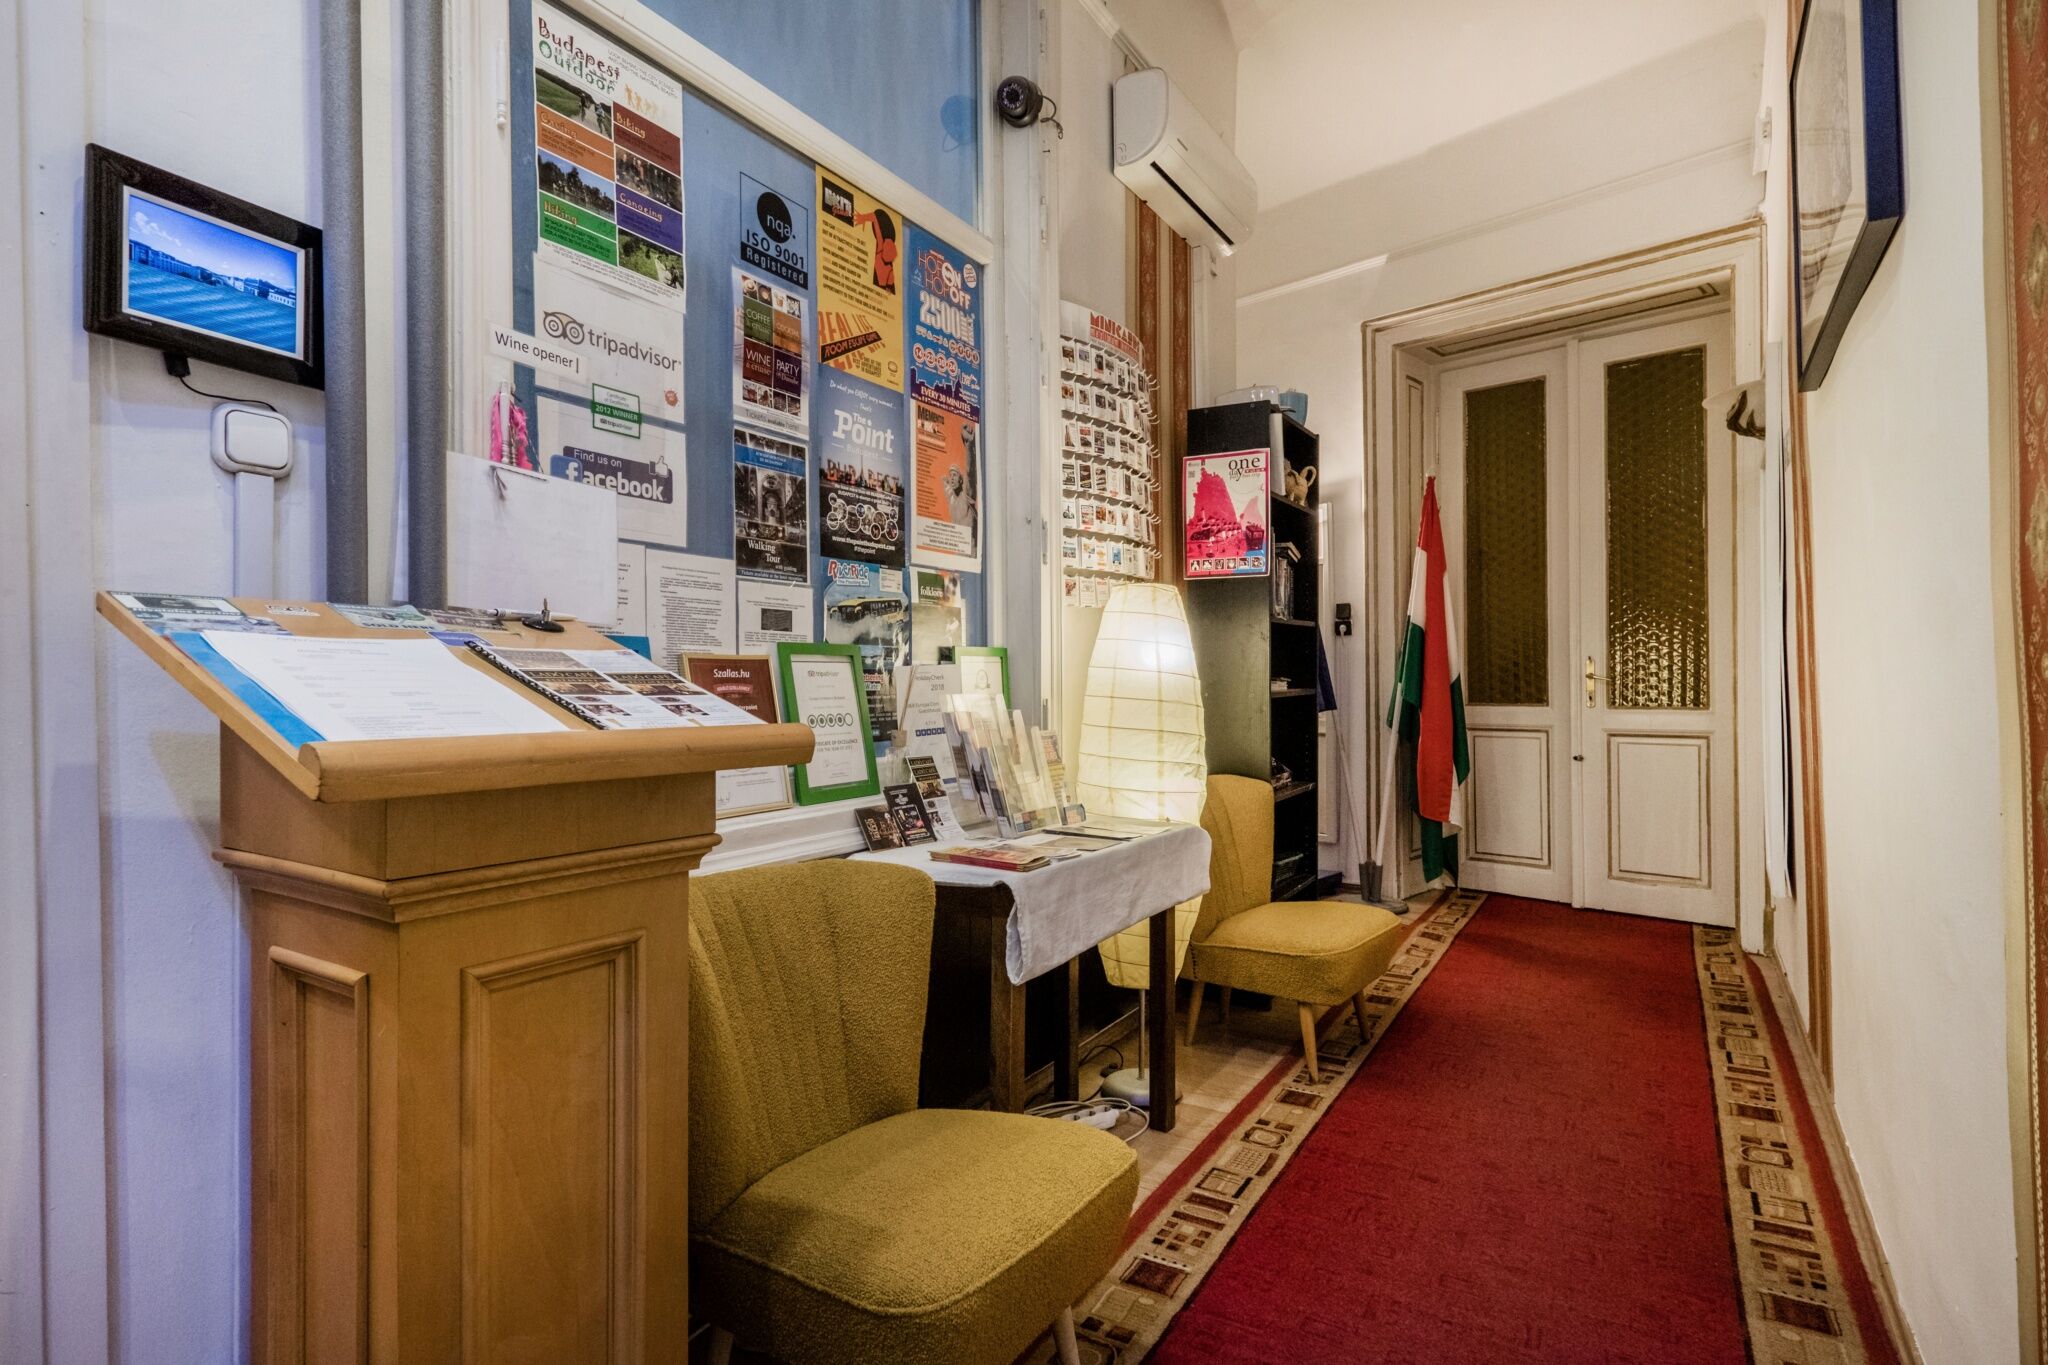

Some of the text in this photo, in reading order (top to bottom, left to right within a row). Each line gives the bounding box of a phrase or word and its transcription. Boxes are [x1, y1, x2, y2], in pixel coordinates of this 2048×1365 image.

[538, 17, 620, 80] Budapest
[538, 40, 616, 94] Outdoor
[541, 112, 577, 139] Caving
[616, 112, 645, 139] Biking
[544, 201, 577, 225] Hiking
[619, 192, 662, 222] Canoeing
[747, 229, 770, 252] ISO
[775, 244, 804, 270] 9001
[746, 247, 804, 284] Registered
[950, 286, 970, 310] OFF
[746, 308, 770, 324] COFFEE
[495, 330, 573, 370] Wine opener
[587, 329, 678, 372] tripadvisor
[745, 348, 771, 367] WINE
[825, 341, 848, 358] ROOM
[776, 359, 800, 377] PARTY
[921, 386, 939, 401] EVERY
[946, 396, 970, 413] MINUTES
[595, 404, 638, 422] 2012 WINNER
[853, 412, 866, 424] The
[832, 409, 895, 454] Point
[574, 449, 622, 468] Find us on
[1229, 457, 1261, 471] one
[566, 461, 664, 501] facebook
[1229, 468, 1244, 481] day
[748, 540, 776, 554] Walking
[765, 553, 781, 563] Tour
[828, 560, 870, 581] RiverRide
[920, 586, 943, 597] folklore
[713, 668, 751, 678] Szallas.hu
